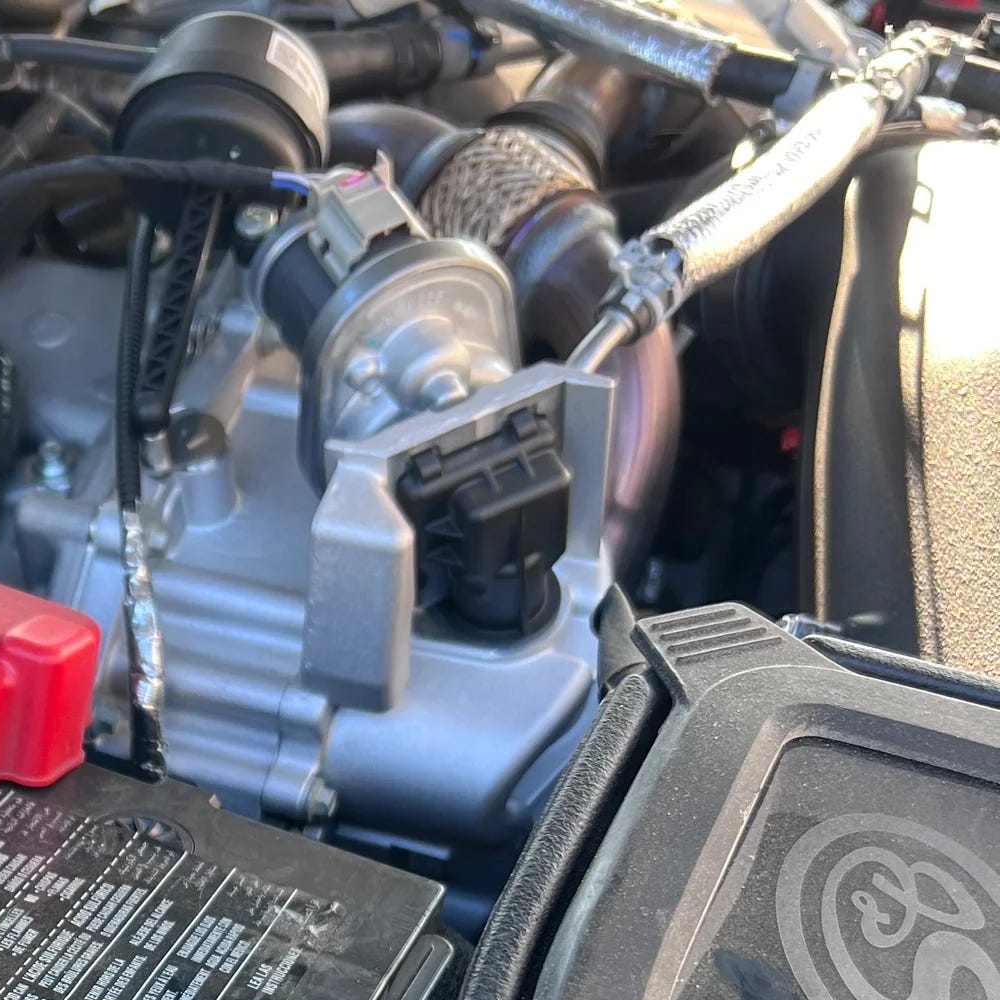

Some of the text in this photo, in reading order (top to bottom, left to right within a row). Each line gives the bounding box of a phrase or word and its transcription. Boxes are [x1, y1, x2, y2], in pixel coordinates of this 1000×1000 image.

[38, 929, 75, 963] SULFURIQUE
[12, 982, 29, 995] CAN
[246, 963, 273, 990] LEA LAS
